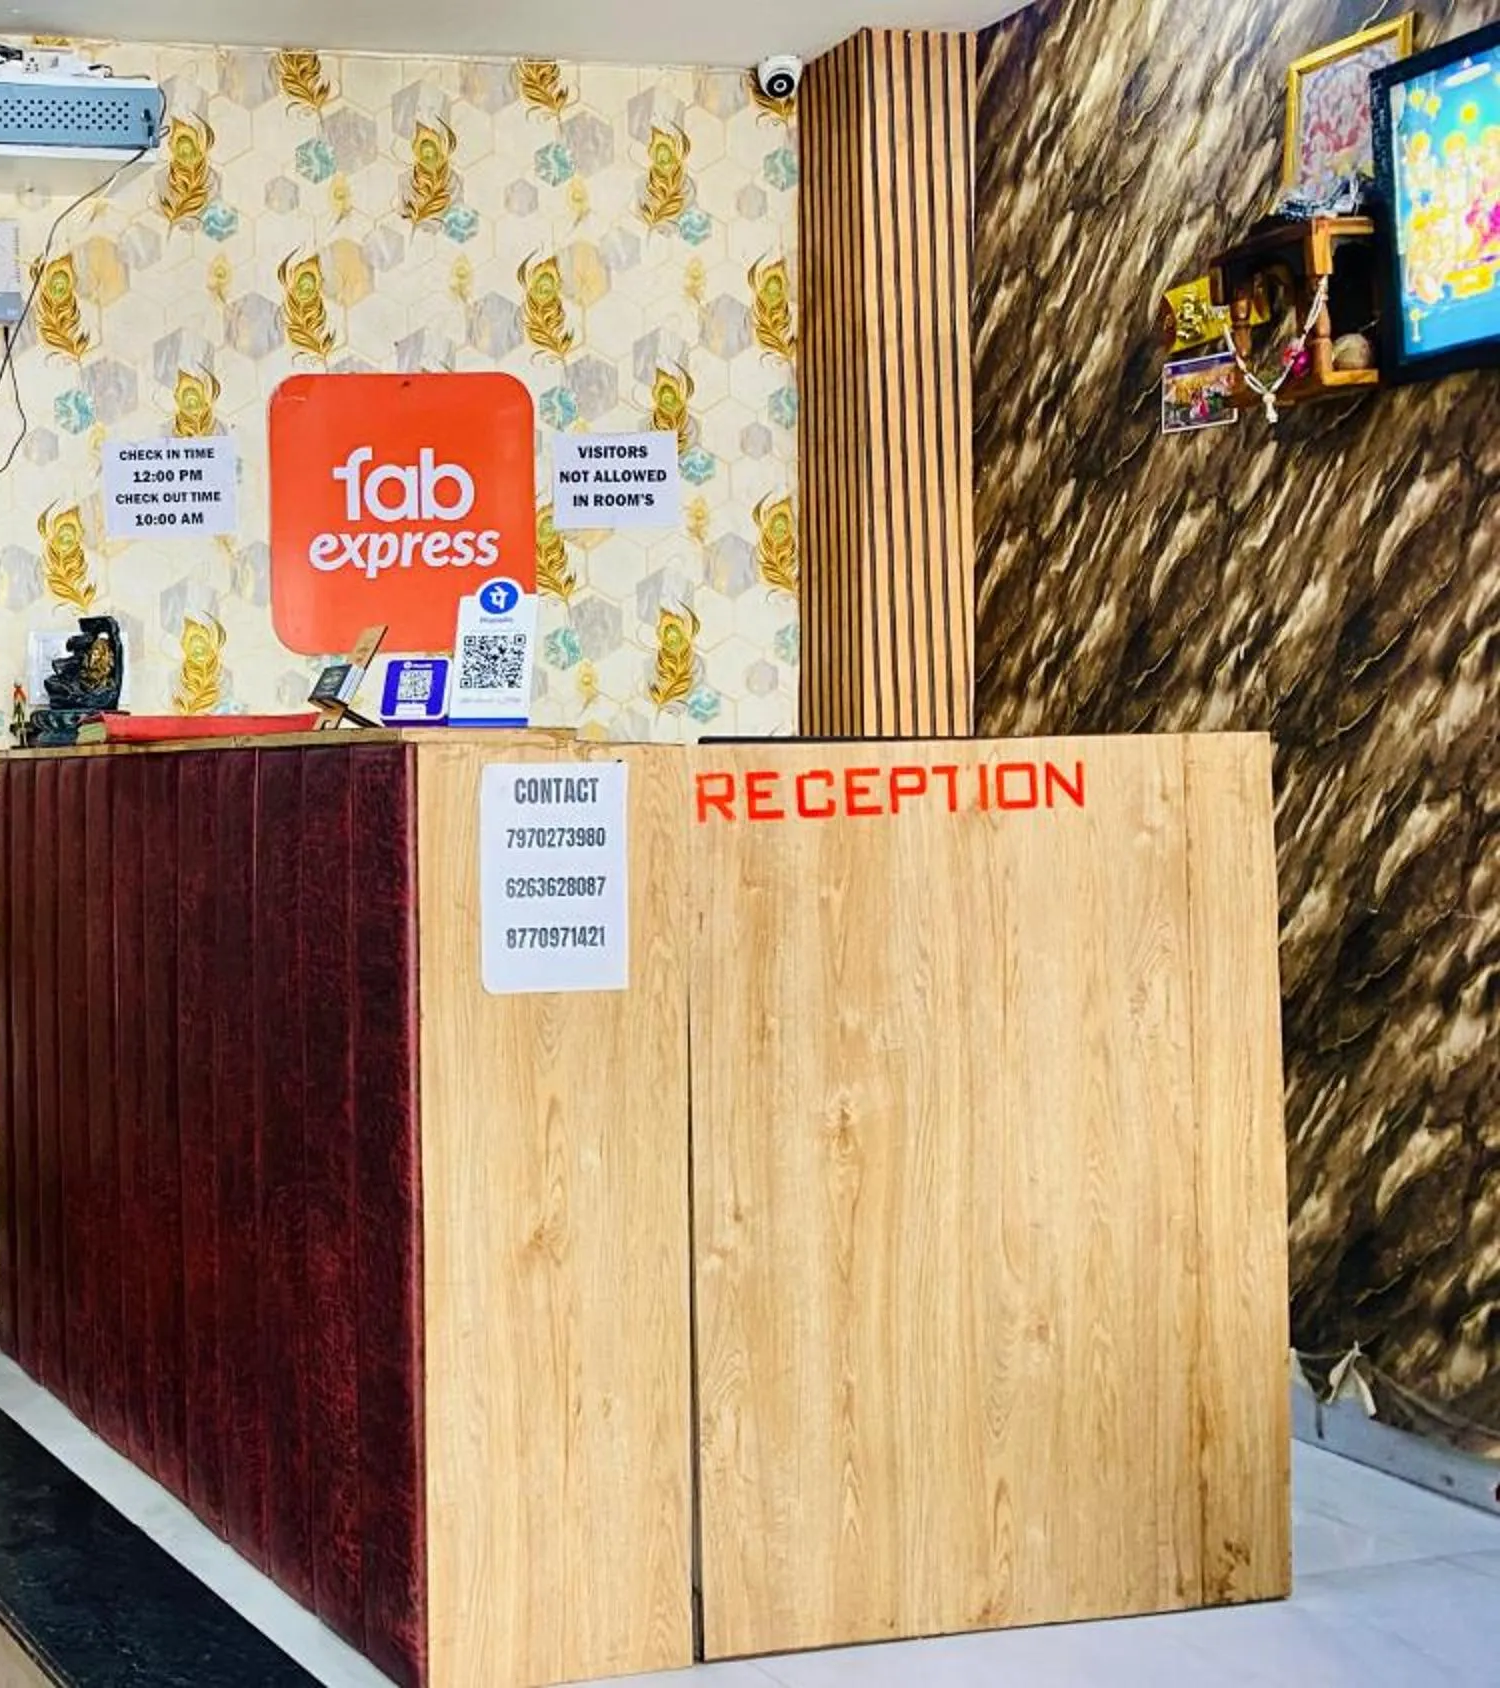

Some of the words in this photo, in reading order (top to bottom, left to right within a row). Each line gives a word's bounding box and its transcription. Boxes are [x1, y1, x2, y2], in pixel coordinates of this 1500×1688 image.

[119, 449, 163, 461] CHECK
[167, 449, 180, 459] IN
[184, 447, 215, 459] TIME
[578, 445, 648, 459] VISITORS
[133, 470, 175, 483] 12:00
[179, 469, 203, 482] PM
[332, 446, 475, 522] fab
[559, 470, 589, 483] NOT
[593, 469, 667, 483] ALLOWED
[115, 493, 159, 505] CHECK
[162, 492, 187, 503] OUT
[190, 491, 221, 502] TIME
[573, 494, 589, 507] IN
[593, 493, 655, 507] ROOM'S
[135, 513, 177, 527] 10:00
[181, 512, 204, 525] AM
[309, 530, 501, 579] express
[514, 777, 599, 804] CONTACT
[695, 761, 1085, 823] RECEPTION
[506, 827, 606, 848] 7970273980
[506, 876, 606, 898] 6263628087
[506, 925, 605, 949] 8770971421
